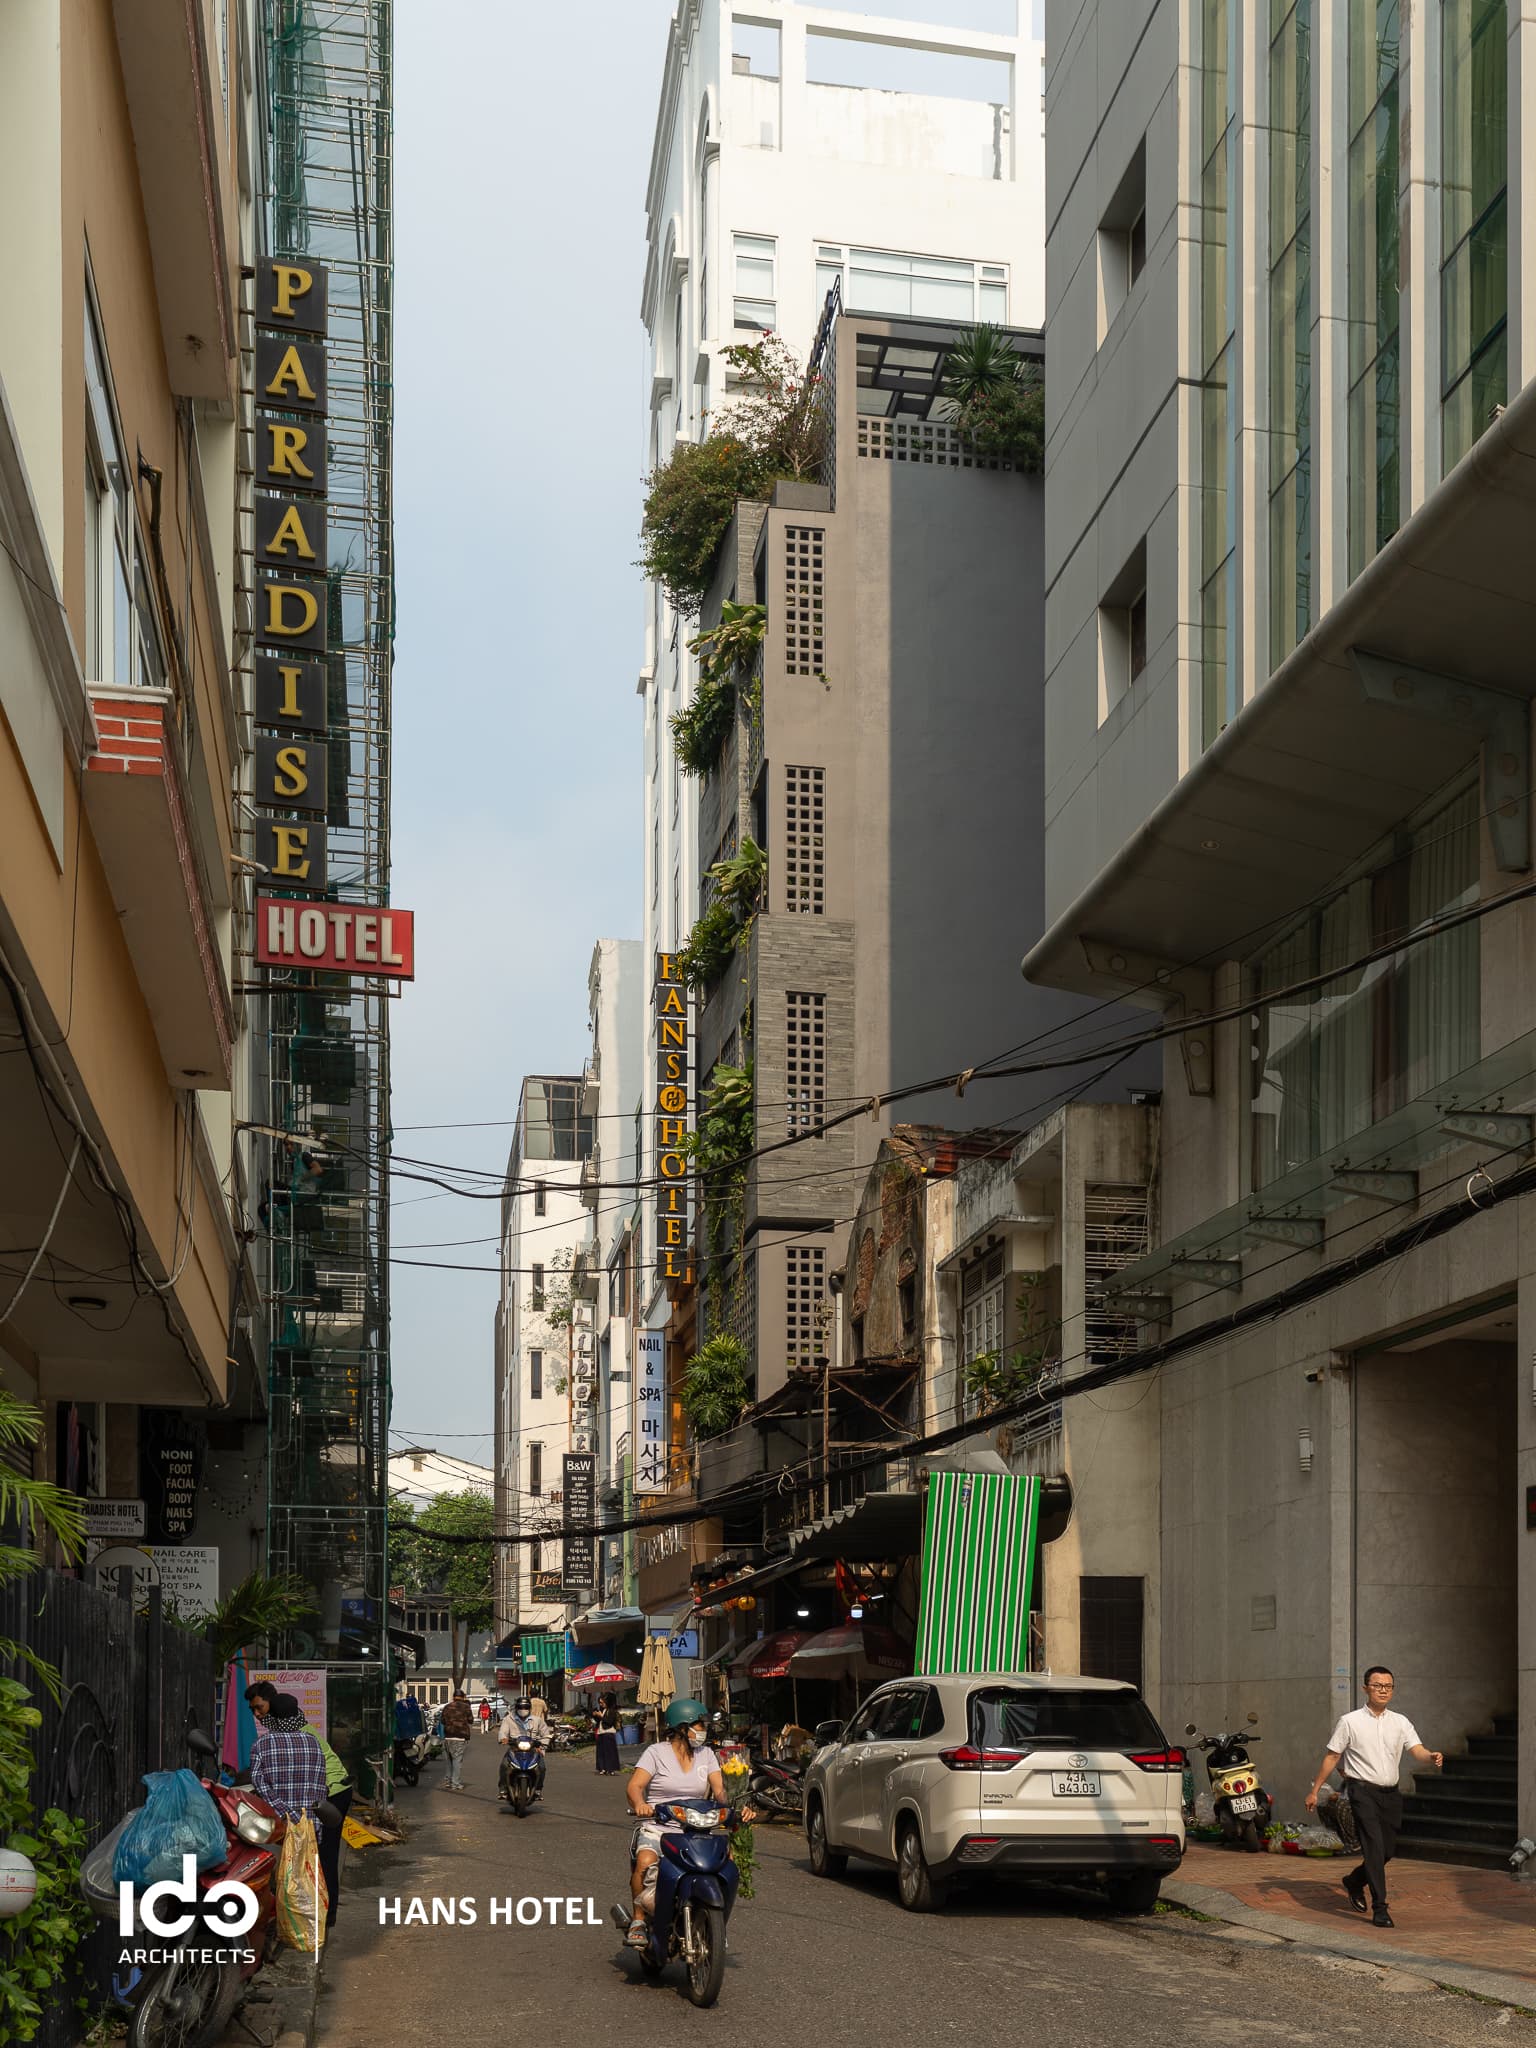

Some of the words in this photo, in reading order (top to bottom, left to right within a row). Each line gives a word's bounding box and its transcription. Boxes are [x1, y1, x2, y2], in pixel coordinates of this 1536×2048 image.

[264, 263, 319, 880] PARADISE
[267, 905, 403, 965] HOTEL
[660, 954, 686, 1080] HANS
[660, 1119, 686, 1279] HOTEL
[638, 1338, 662, 1352] NAIL
[645, 1361, 655, 1376] &
[639, 1387, 661, 1402] SPA
[160, 1450, 193, 1460] NONI
[640, 1419, 660, 1486] 마사지
[169, 1463, 193, 1474] FOOT
[567, 1460, 591, 1470] B&W
[166, 1478, 197, 1489] FACIAL
[168, 1493, 193, 1504] BODY
[81, 1503, 115, 1516] PARADISE
[117, 1504, 139, 1517] HOTEL
[166, 1507, 193, 1518] NAILS
[168, 1521, 186, 1532] SPA
[179, 1550, 207, 1558] CARE
[183, 1582, 202, 1590] SPA
[183, 1598, 203, 1606] SPA
[255, 1673, 277, 1682] NONI
[1065, 1772, 1087, 1783] 43A
[1058, 1783, 1096, 1794] 843.03
